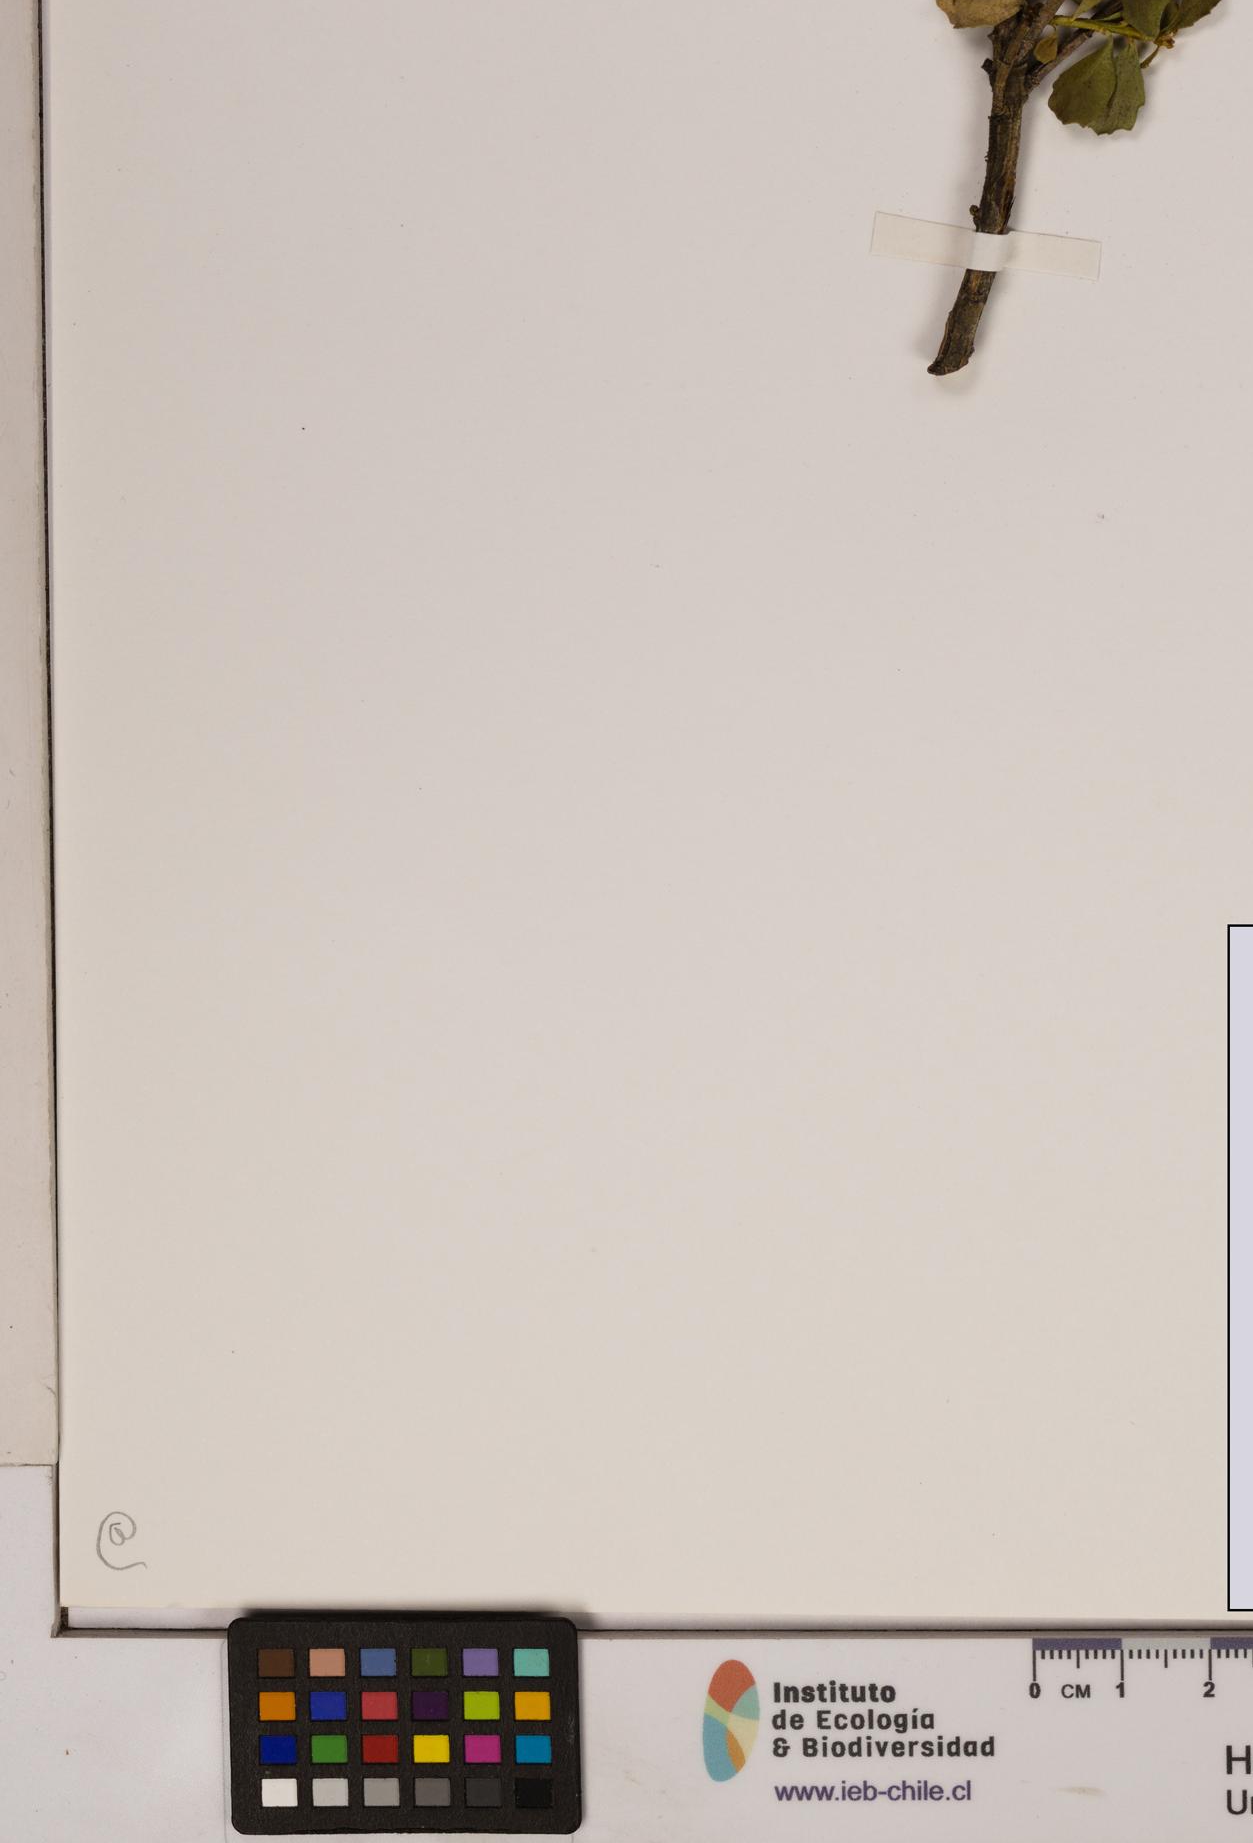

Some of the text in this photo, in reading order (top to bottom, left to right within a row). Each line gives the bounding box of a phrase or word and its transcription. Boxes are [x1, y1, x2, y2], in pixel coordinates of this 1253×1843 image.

[773, 1679, 897, 1704] Instituto
[1029, 1682, 1042, 1699] 0
[1060, 1683, 1091, 1699] CM
[1115, 1681, 1125, 1699] 1
[1203, 1681, 1216, 1698] 2
[771, 1707, 935, 1734] de Ecología
[772, 1735, 995, 1758] & Biodiversidad
[774, 1779, 972, 1802] www.ieb-chile.cl
